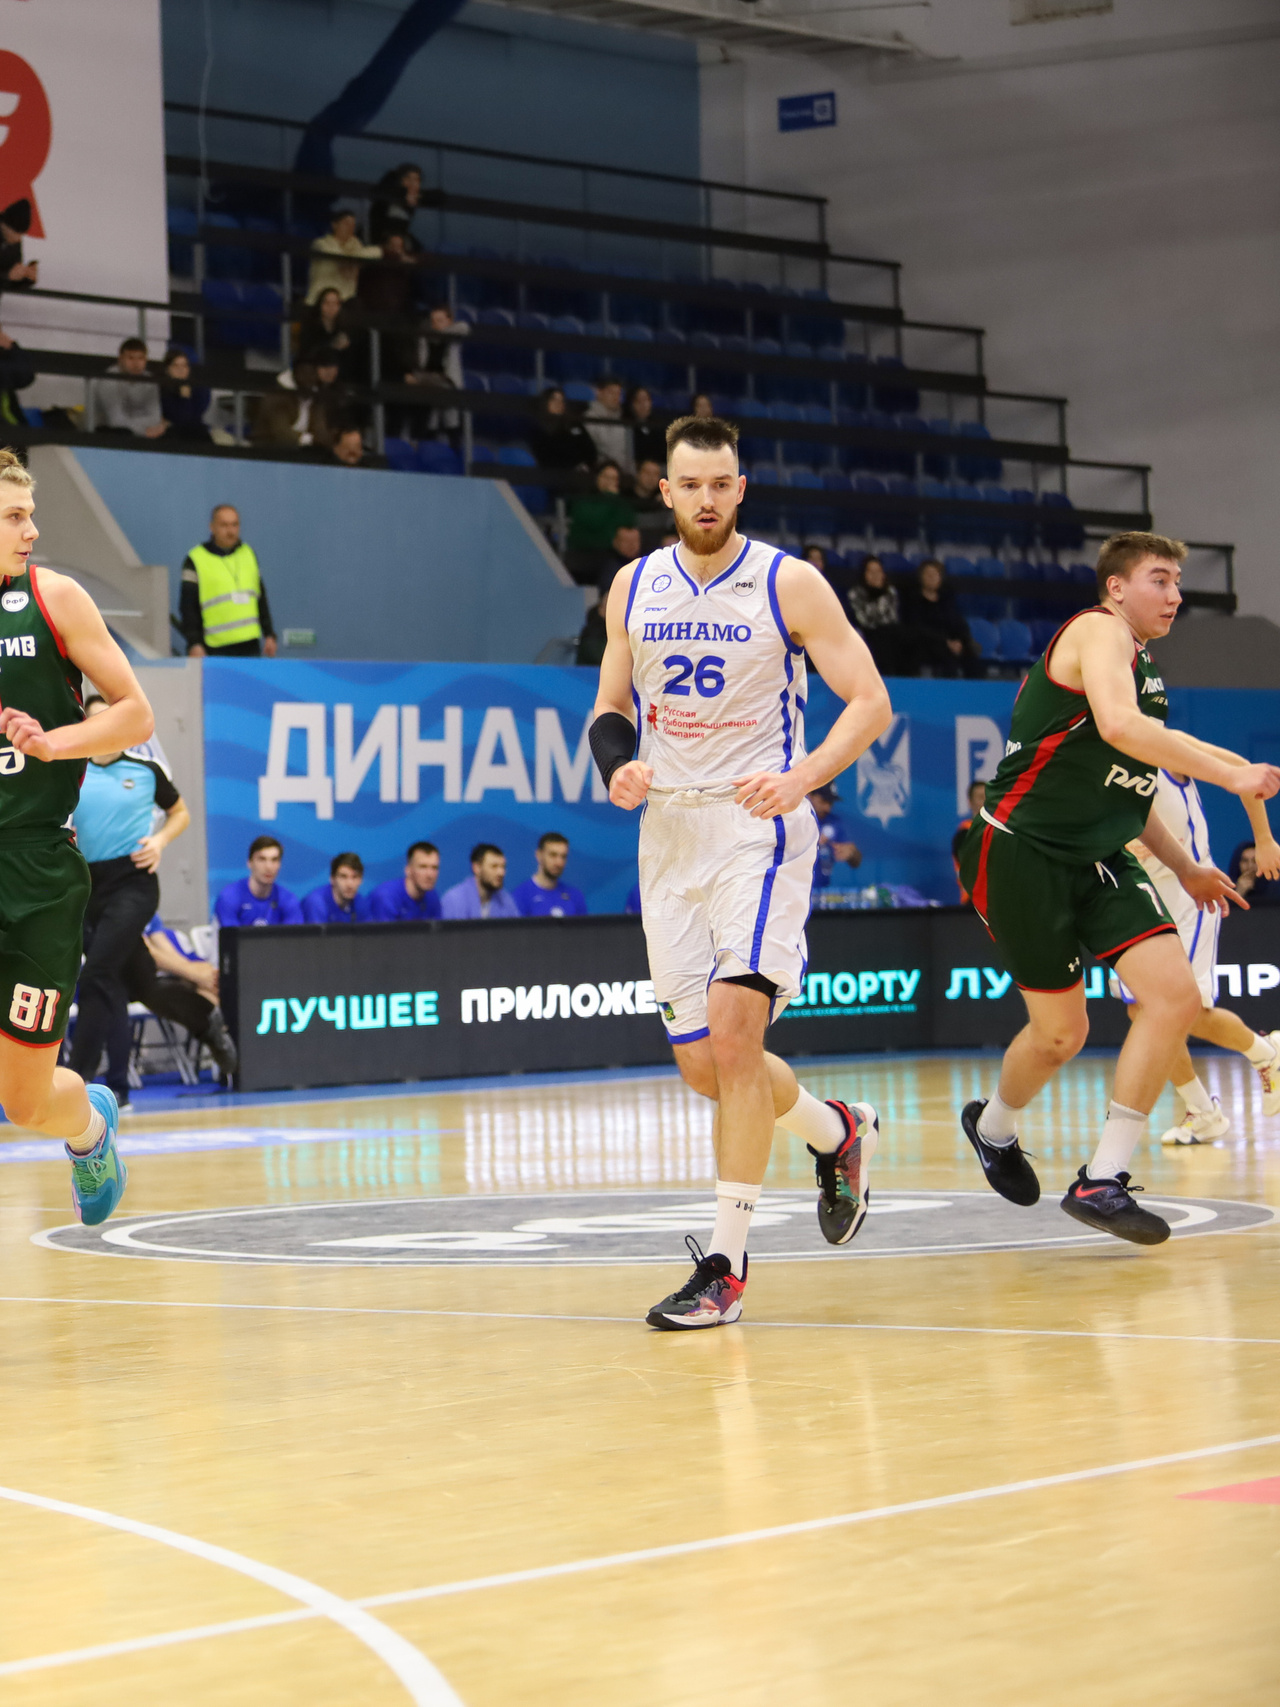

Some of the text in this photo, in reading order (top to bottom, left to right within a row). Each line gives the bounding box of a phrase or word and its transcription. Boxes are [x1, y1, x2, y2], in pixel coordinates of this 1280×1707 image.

[642, 622, 752, 643] ДИНАМО
[662, 654, 726, 699] 26
[662, 726, 706, 739] Компания
[663, 705, 697, 719] Русская
[258, 701, 615, 821] ДИНАМ
[9, 982, 60, 1032] 81
[256, 979, 663, 1035] ЛУЧШЕЕ ПРИЛОЖЕ
